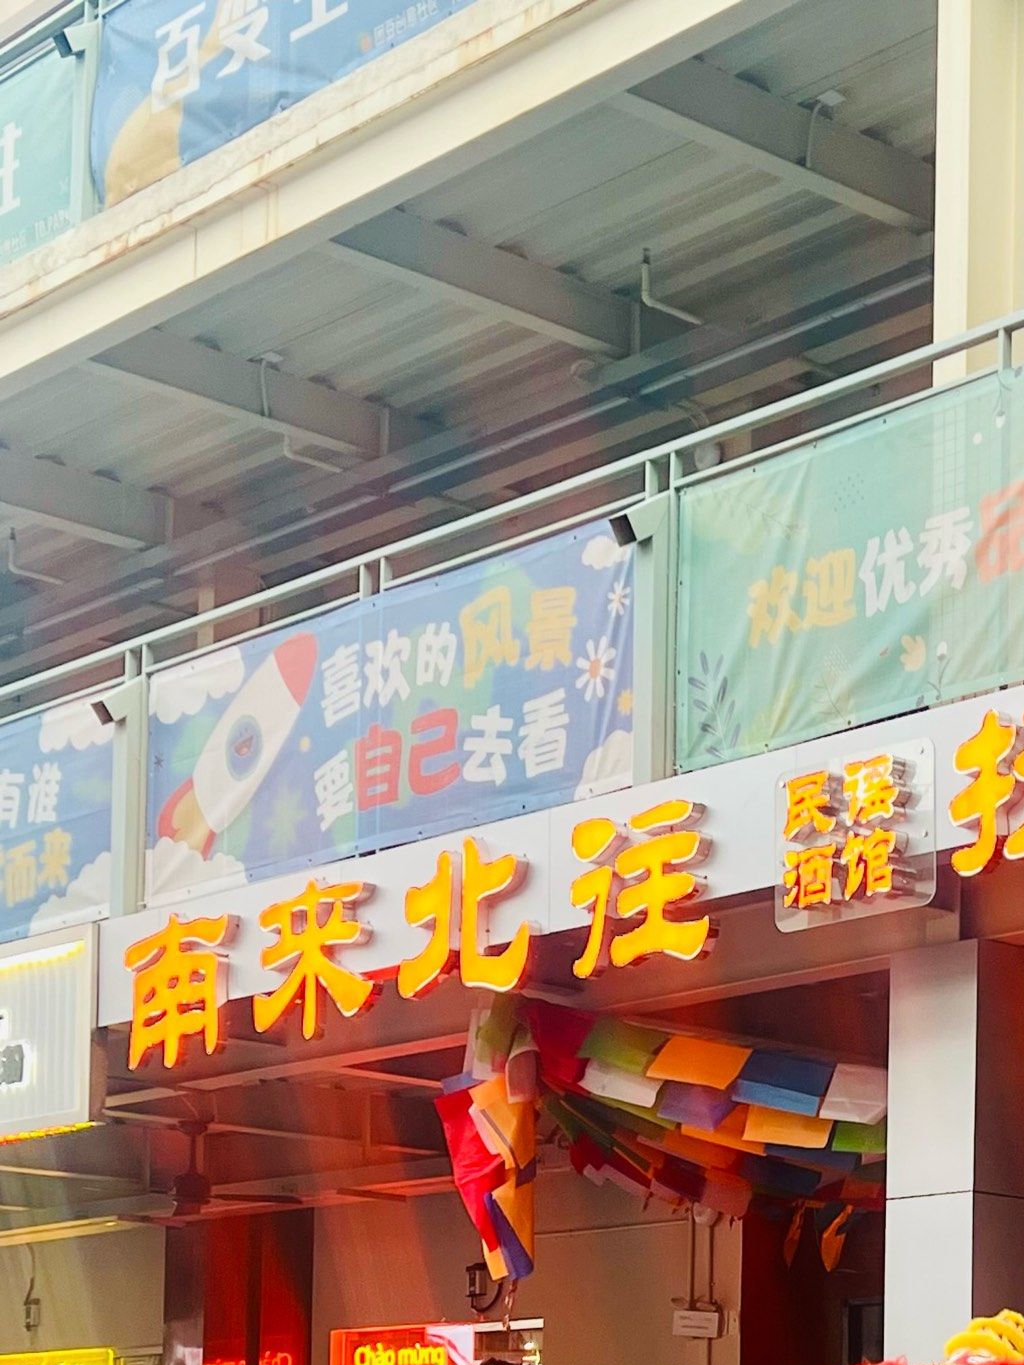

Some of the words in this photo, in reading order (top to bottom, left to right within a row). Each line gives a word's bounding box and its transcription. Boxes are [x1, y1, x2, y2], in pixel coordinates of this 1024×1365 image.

[320, 585, 577, 728] 喜欢的风景
[313, 688, 569, 832] 要自己去看
[0, 826, 71, 907] 而来
[124, 799, 711, 1071] 南来北往
[784, 828, 896, 909] 酒馆
